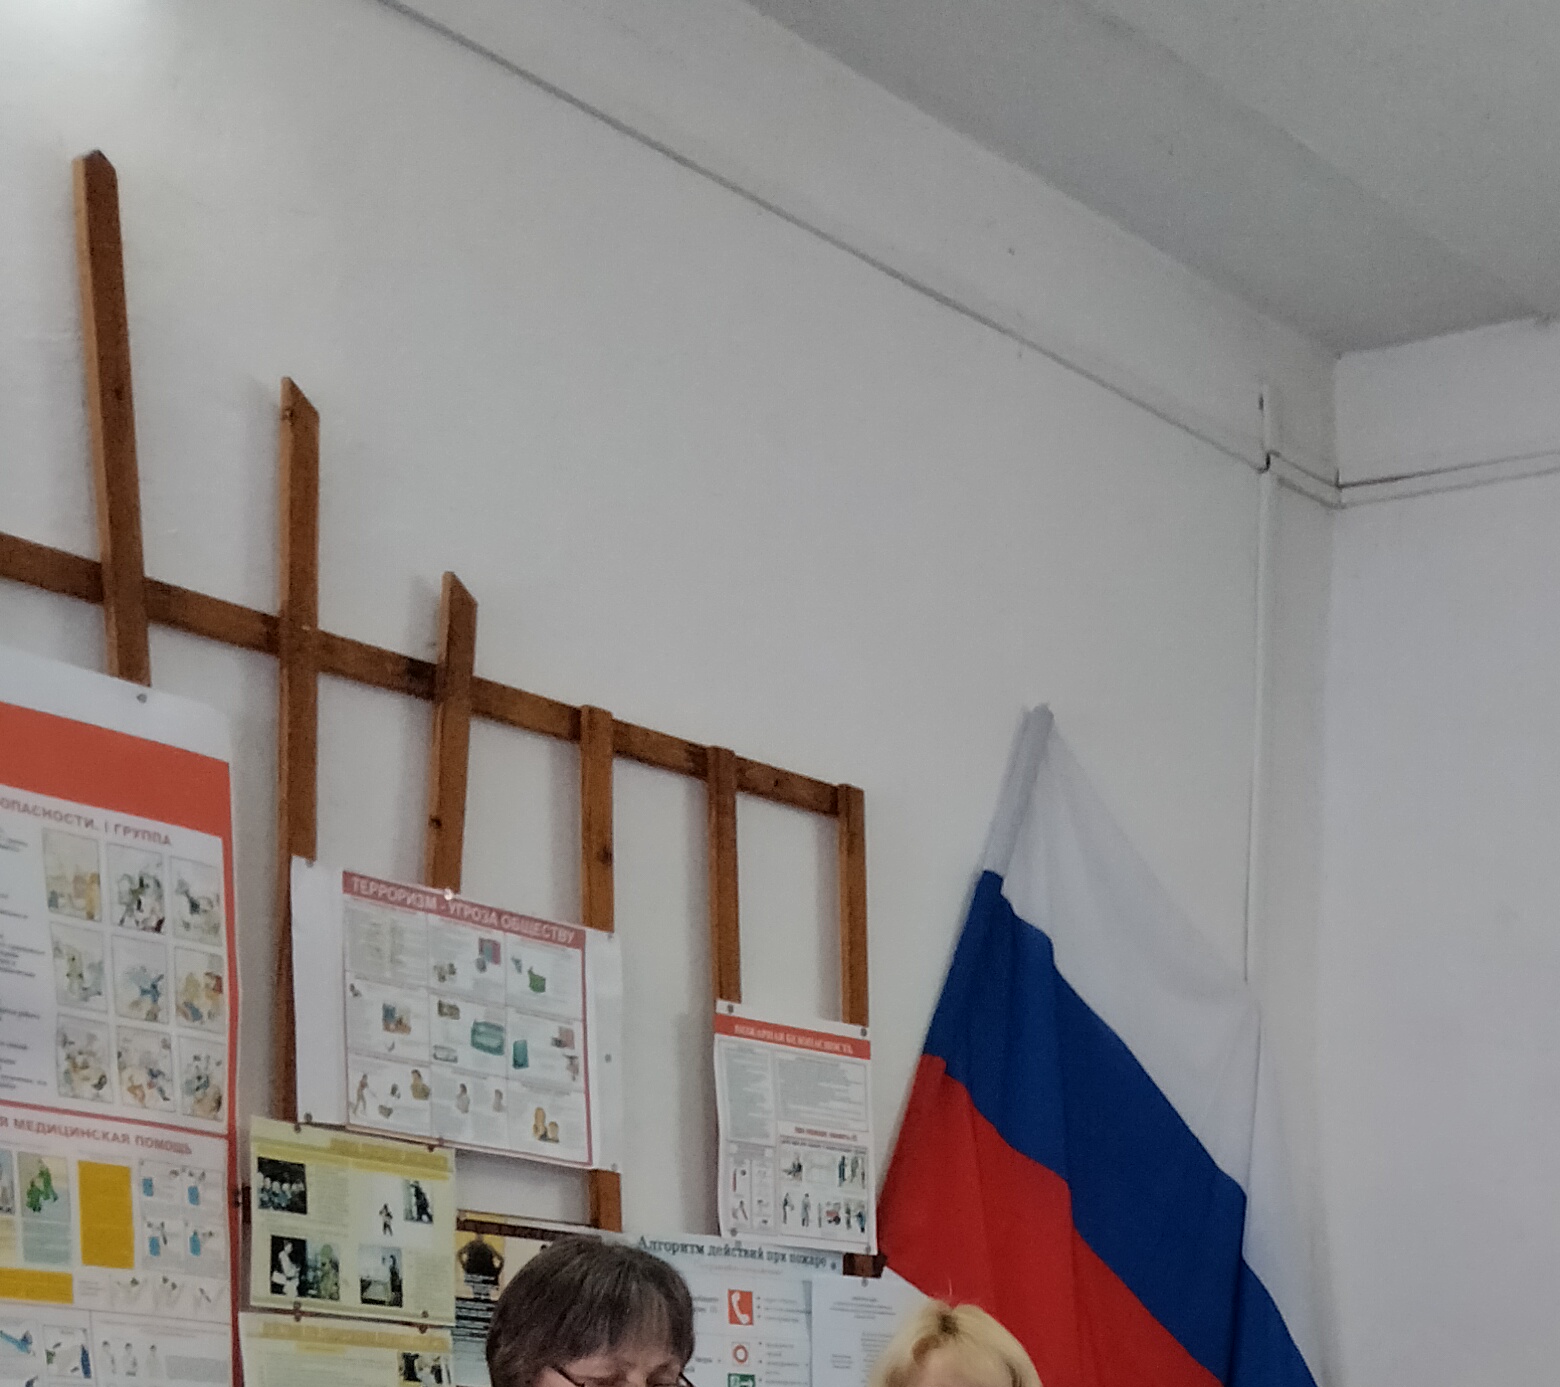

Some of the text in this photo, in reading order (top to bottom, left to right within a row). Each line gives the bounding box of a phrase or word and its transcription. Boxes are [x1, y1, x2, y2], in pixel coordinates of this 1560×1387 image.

[114, 823, 171, 845] ГРУППА
[352, 877, 437, 908] ТЕРРОРИЗМ
[449, 901, 498, 926] УГРОЗА
[501, 917, 575, 943] ОБЩЕСТВУ
[14, 1118, 130, 1144] МЕДИЦИНСКАЯ
[135, 1135, 192, 1154] ПОМОЩЬ
[638, 1235, 827, 1270] Алгоритм действий при пожаре
